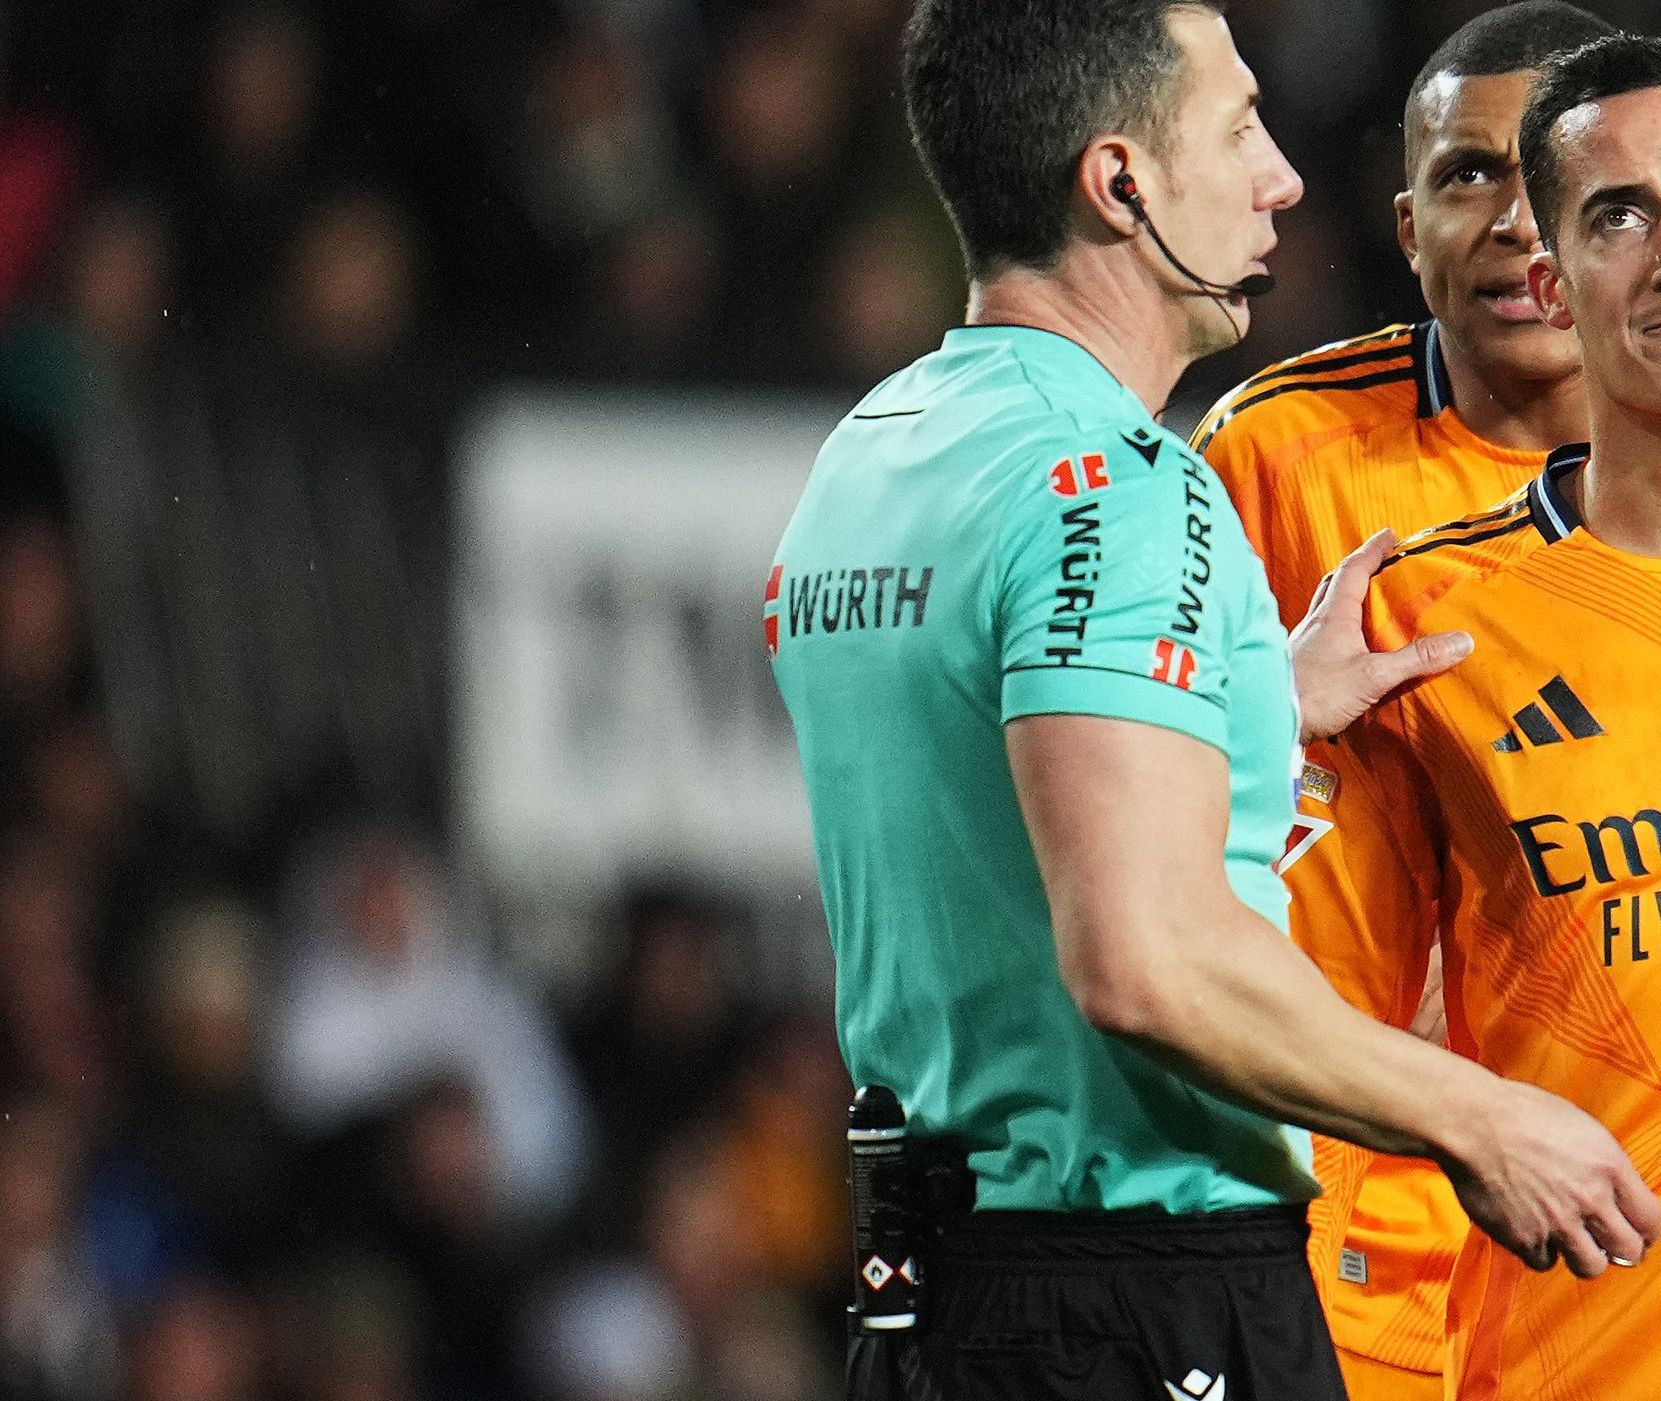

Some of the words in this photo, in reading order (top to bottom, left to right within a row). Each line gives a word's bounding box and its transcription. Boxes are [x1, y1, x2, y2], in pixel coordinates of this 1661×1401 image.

[789, 566, 934, 638] WÜRTH
[1045, 502, 1101, 667] WÜRTH
[1170, 453, 1211, 636] WÜRTH
